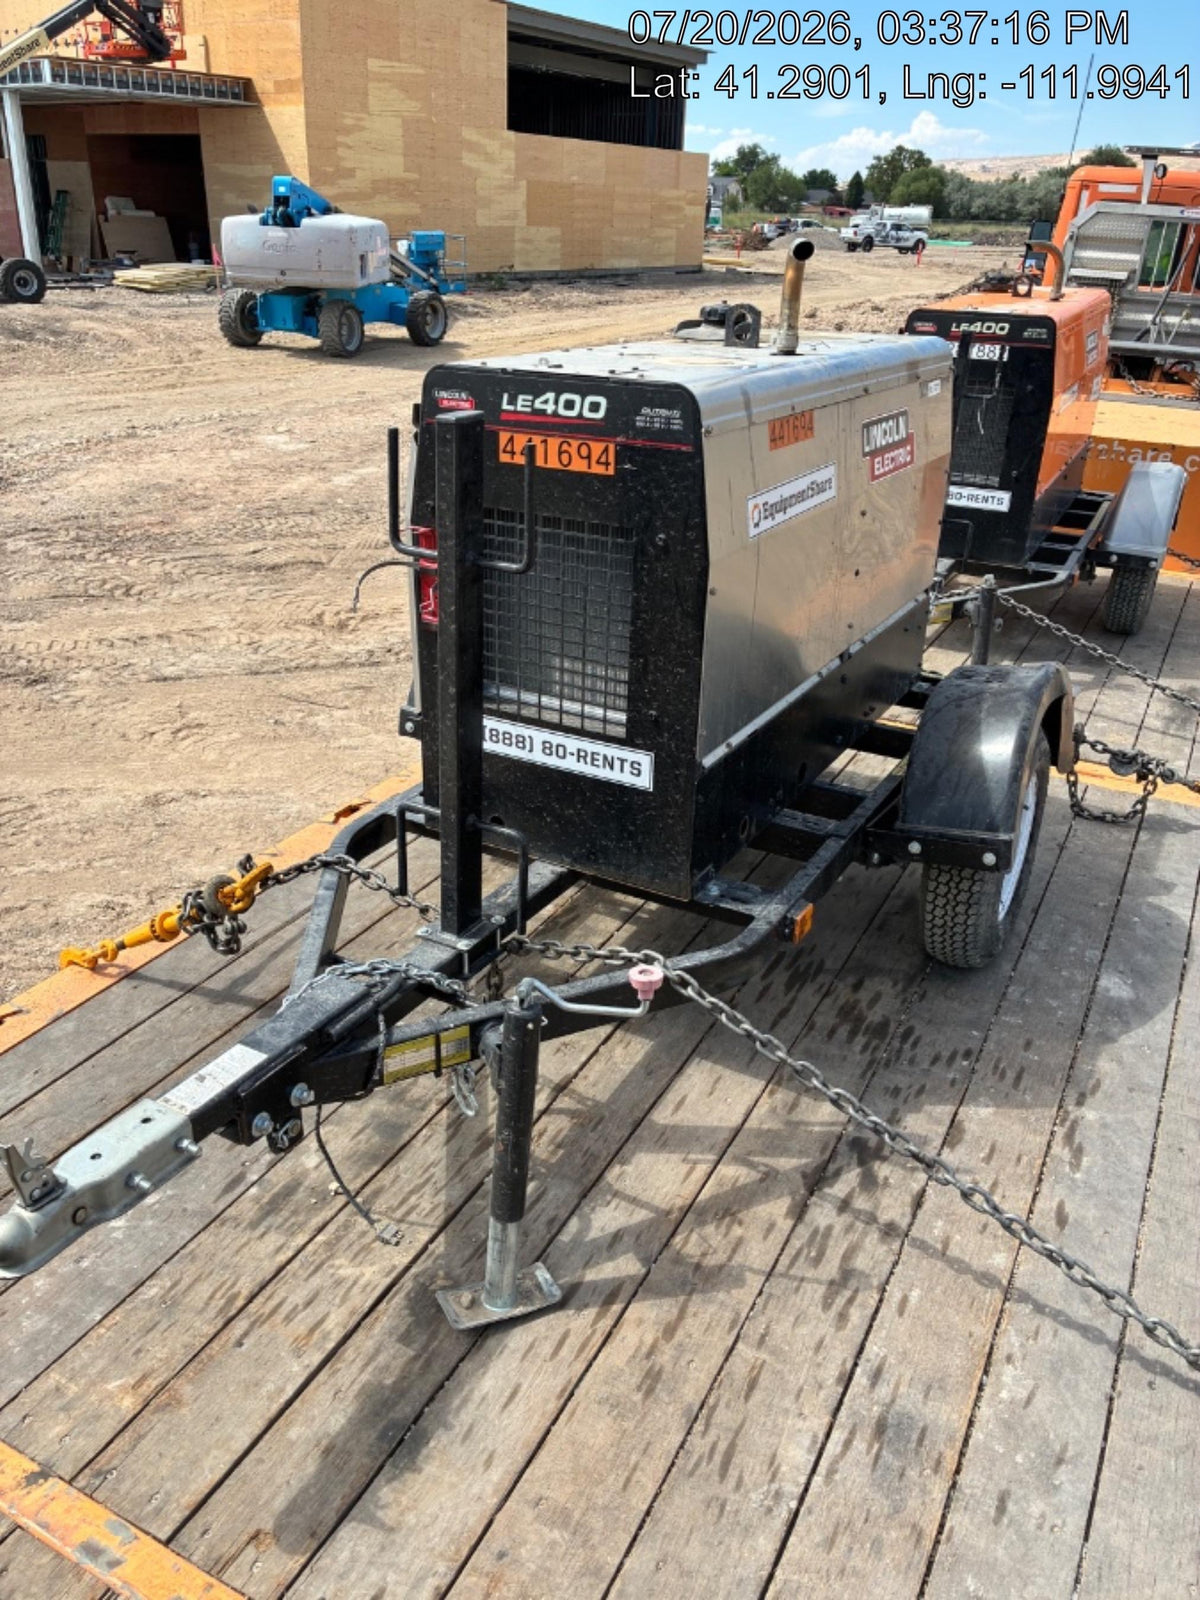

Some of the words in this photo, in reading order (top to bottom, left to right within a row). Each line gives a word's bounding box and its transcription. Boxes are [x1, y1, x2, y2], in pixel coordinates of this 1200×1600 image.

[501, 391, 607, 419] LE400
[769, 410, 814, 446] 441694
[863, 414, 907, 453] LINCOLN
[874, 445, 911, 475] ELECTRIC
[762, 477, 833, 520] EquipmentShare
[541, 740, 643, 778] 80-RENTS
